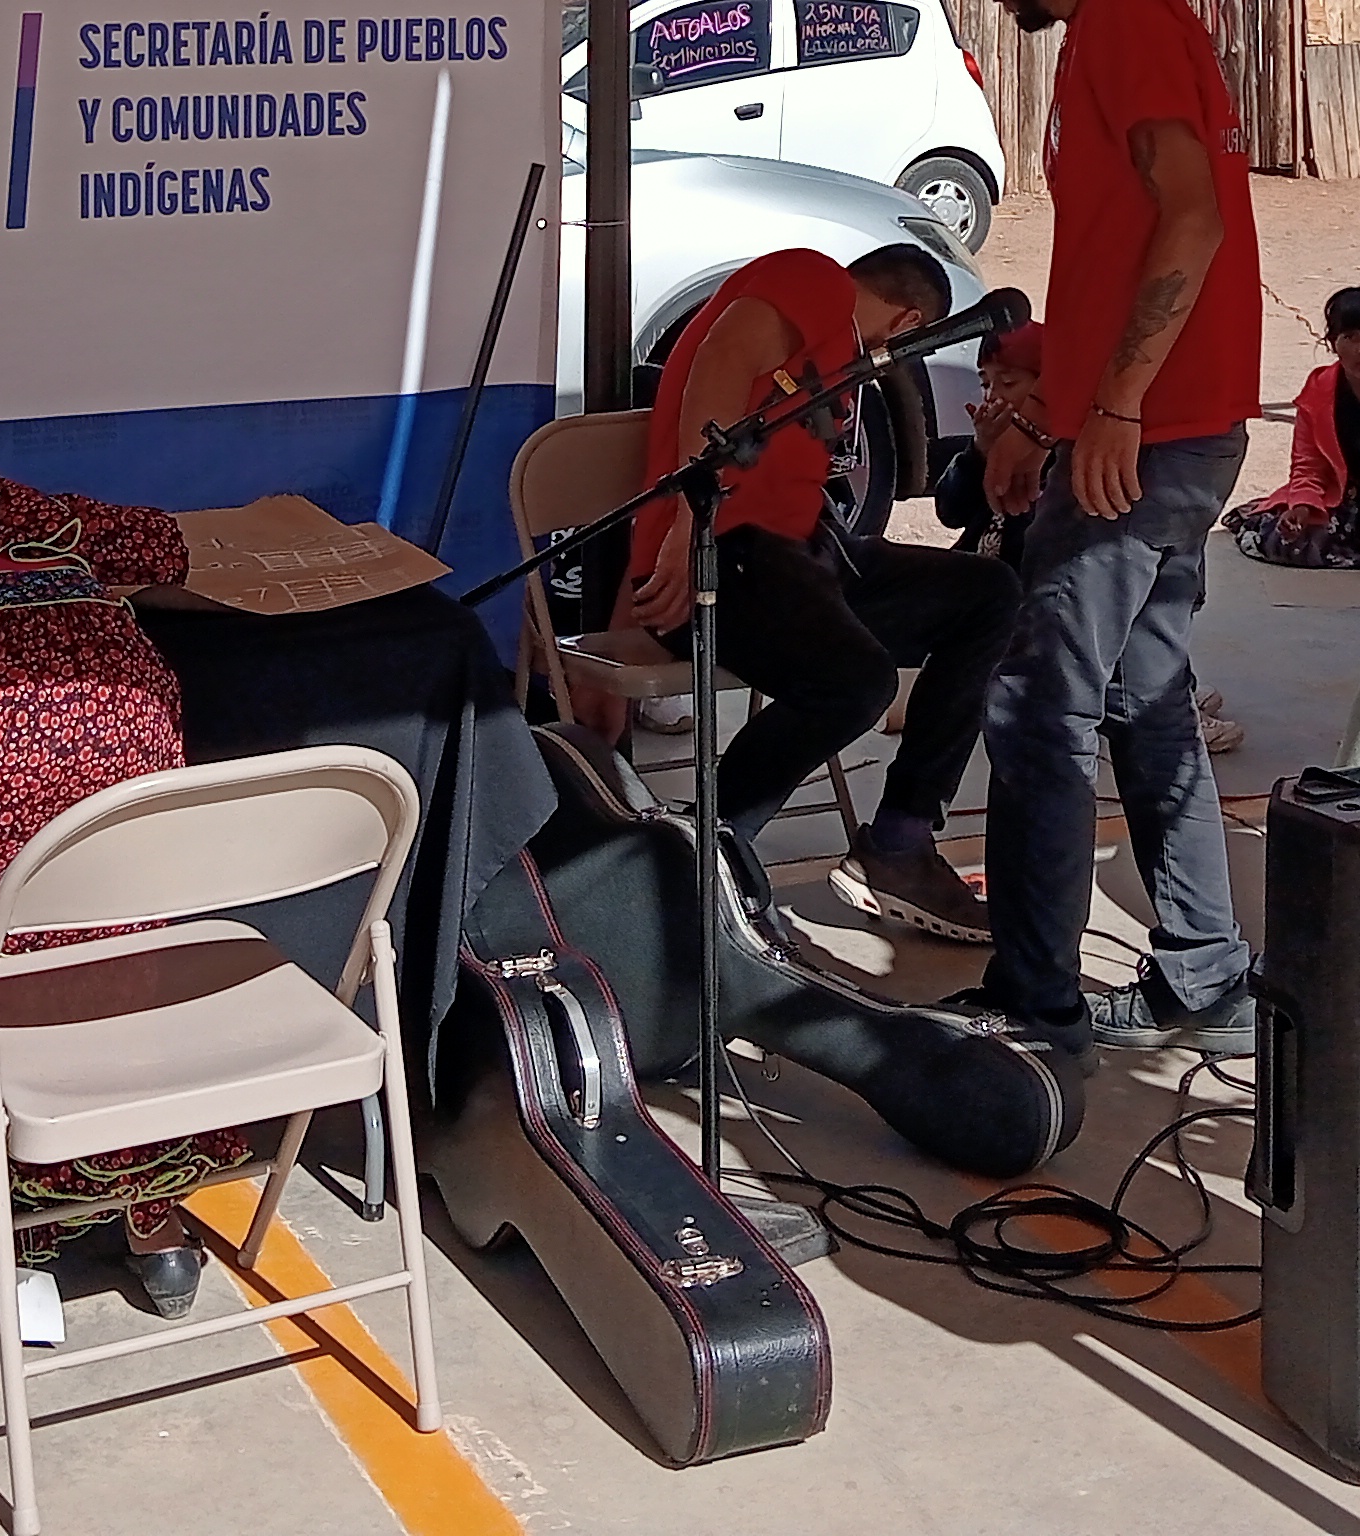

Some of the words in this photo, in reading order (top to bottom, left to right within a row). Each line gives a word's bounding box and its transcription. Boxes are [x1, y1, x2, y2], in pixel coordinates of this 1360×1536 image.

[79, 12, 292, 69] SECRETARÍA
[303, 19, 345, 64] DE
[357, 16, 508, 62] PUEBLOS
[79, 98, 102, 144] Y
[111, 91, 367, 143] COMUNIDADES
[80, 163, 271, 219] INDÍGENAS
